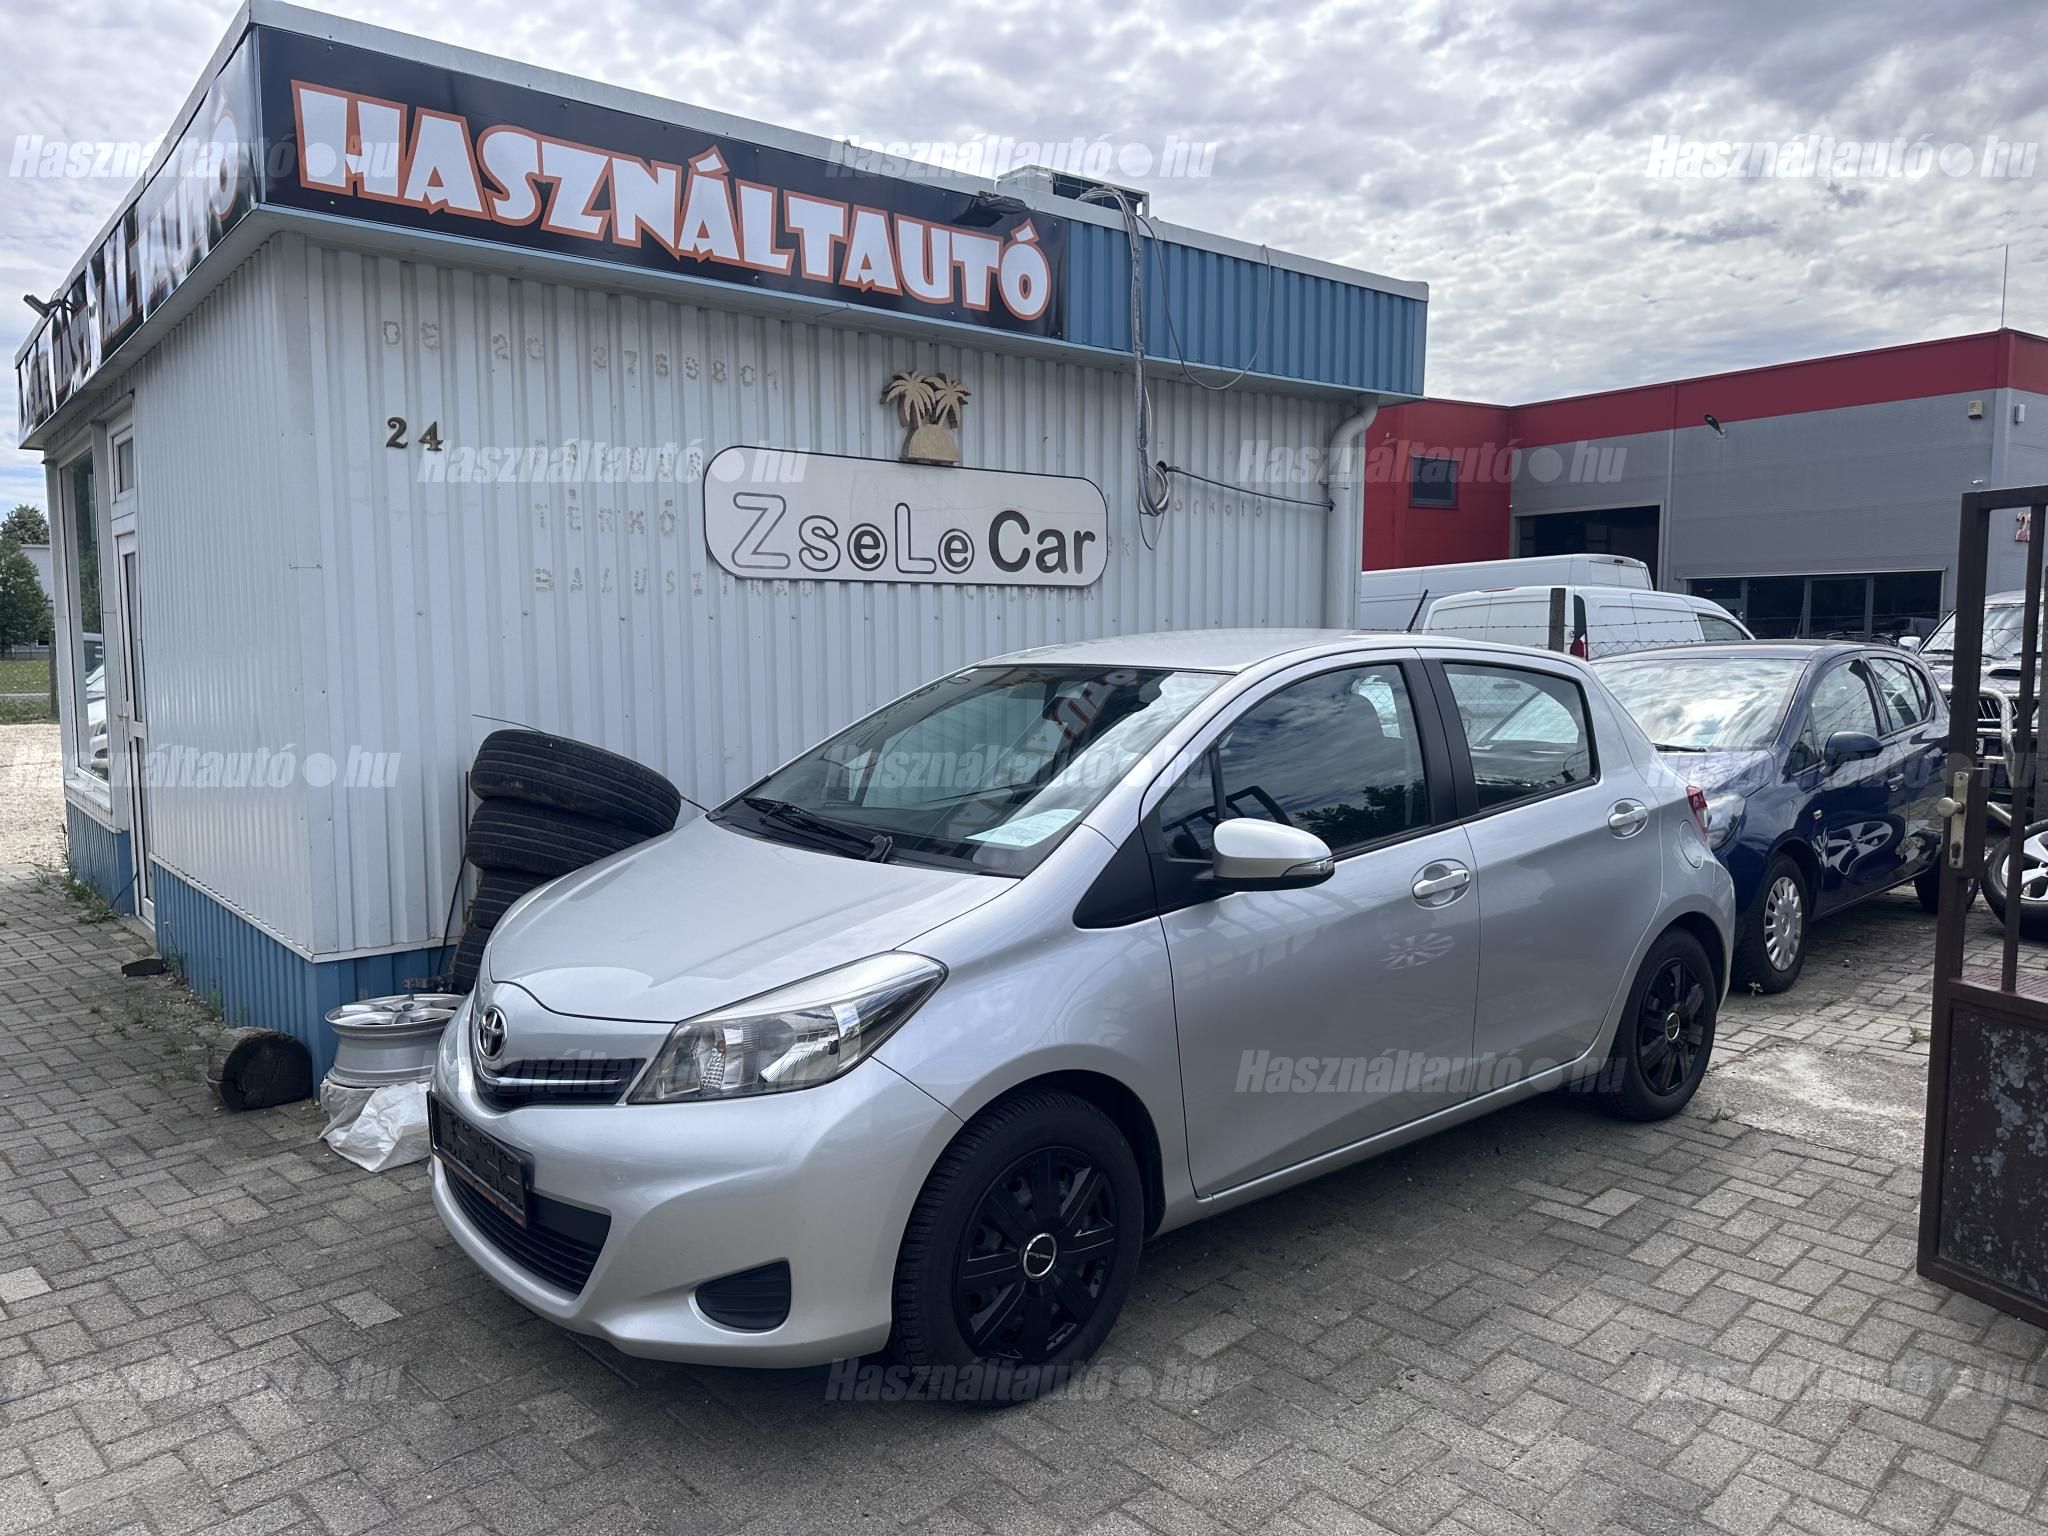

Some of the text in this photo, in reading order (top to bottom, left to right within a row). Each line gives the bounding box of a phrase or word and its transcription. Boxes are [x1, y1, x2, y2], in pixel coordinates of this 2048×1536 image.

[290, 79, 1052, 320] HASZNÁLTAUTÓ
[386, 416, 443, 452] 24
[988, 510, 1096, 574] Car
